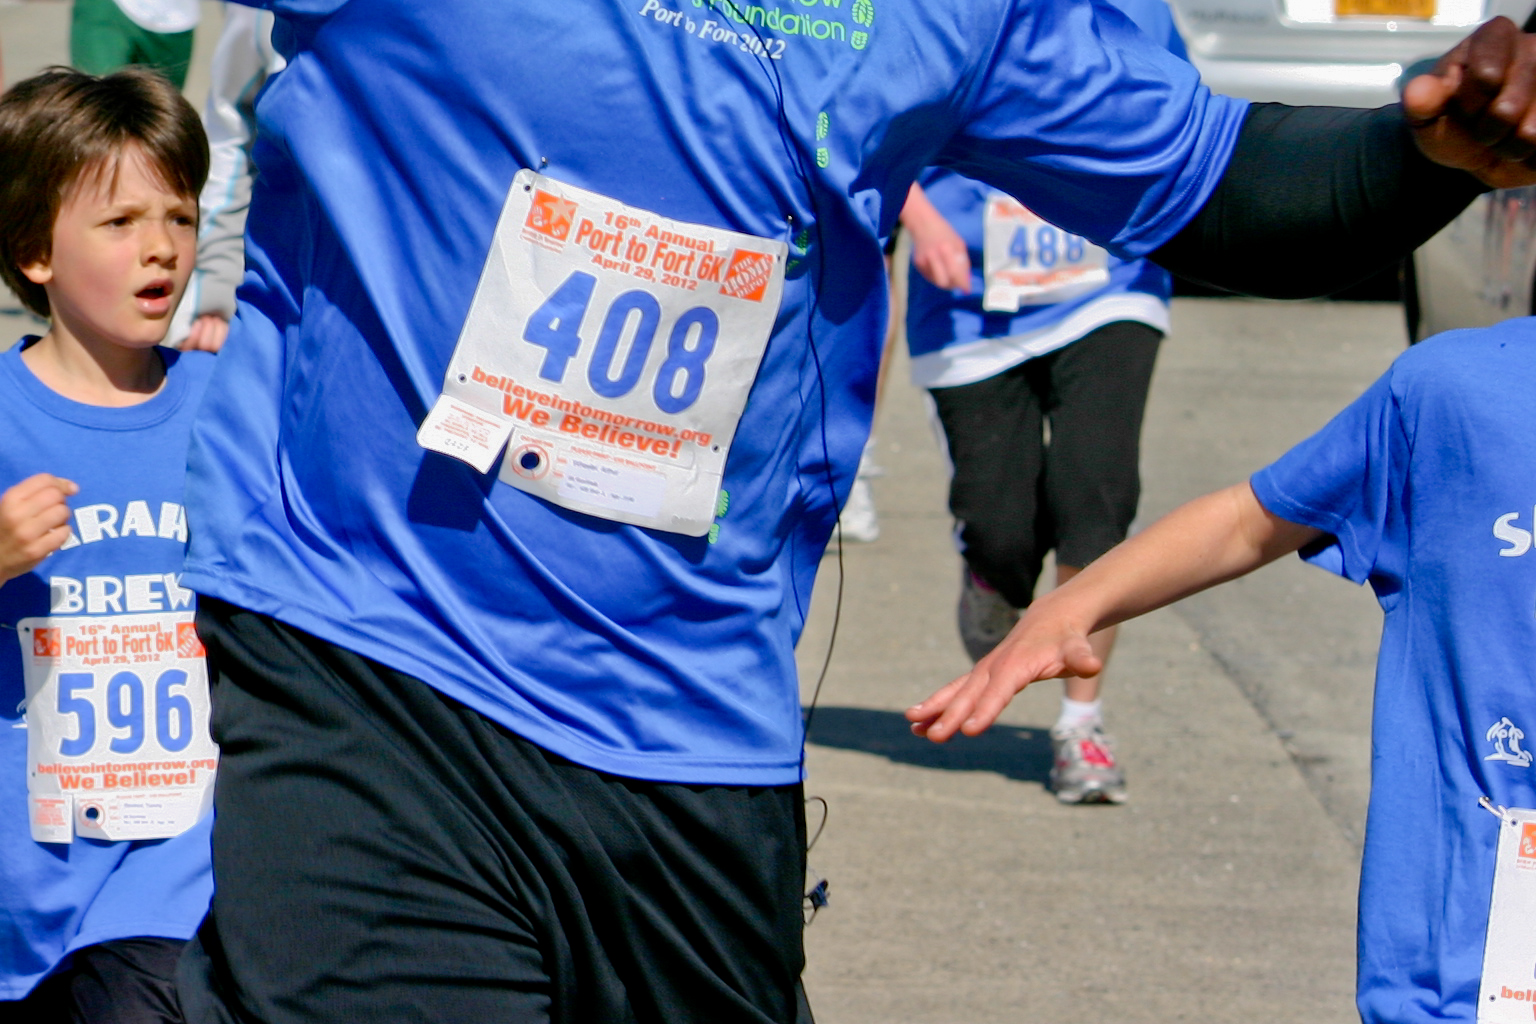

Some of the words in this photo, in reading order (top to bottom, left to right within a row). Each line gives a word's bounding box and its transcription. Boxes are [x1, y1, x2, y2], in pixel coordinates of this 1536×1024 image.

[574, 218, 624, 258] Port
[625, 230, 649, 264] to
[650, 241, 697, 278] Fort
[697, 253, 729, 284] 6K
[604, 211, 643, 230] 16th
[645, 224, 716, 254] Annual
[591, 254, 632, 275] April
[634, 265, 657, 284] 29,
[660, 273, 699, 291] 2012
[522, 270, 719, 415] 408
[471, 366, 713, 447] believeintomorrow.org
[501, 392, 551, 426] We
[559, 413, 684, 459] Believe!
[66, 635, 99, 657] Port
[102, 634, 118, 656] to
[122, 633, 153, 654] Fort
[155, 631, 175, 652] 6K
[111, 622, 162, 635] Annual
[82, 656, 111, 666] April
[133, 653, 162, 664] 2012
[57, 669, 193, 757] 596
[37, 758, 216, 775] believeintomorrow.org
[59, 774, 95, 790] We
[103, 768, 197, 789] Believe!
